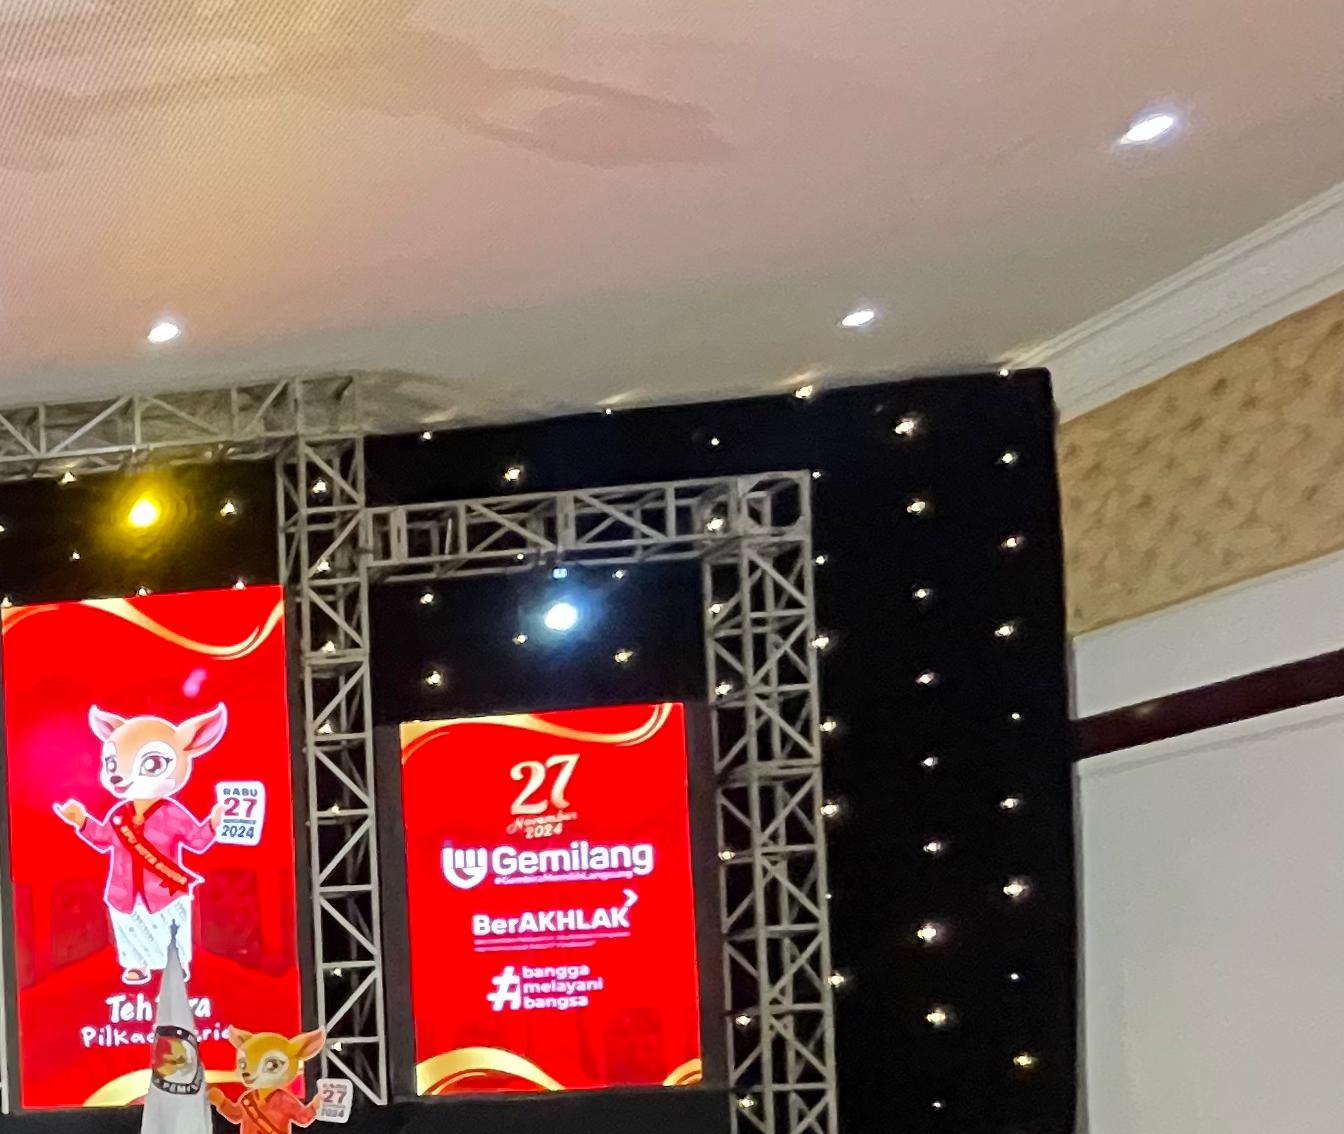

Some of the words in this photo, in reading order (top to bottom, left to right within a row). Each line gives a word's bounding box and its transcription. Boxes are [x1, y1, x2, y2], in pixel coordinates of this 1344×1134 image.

[223, 788, 258, 797] RABU
[510, 753, 581, 815] 27
[224, 797, 258, 818] 27
[221, 825, 255, 839] 2024
[525, 823, 563, 839] 2024
[492, 840, 655, 876] Gemilang
[472, 907, 631, 936] BerAKHLAK
[522, 965, 590, 980] bangga
[523, 977, 604, 995] melayani
[105, 993, 153, 1024] Teh
[523, 995, 590, 1010] bangsa
[322, 1089, 347, 1104] 27
